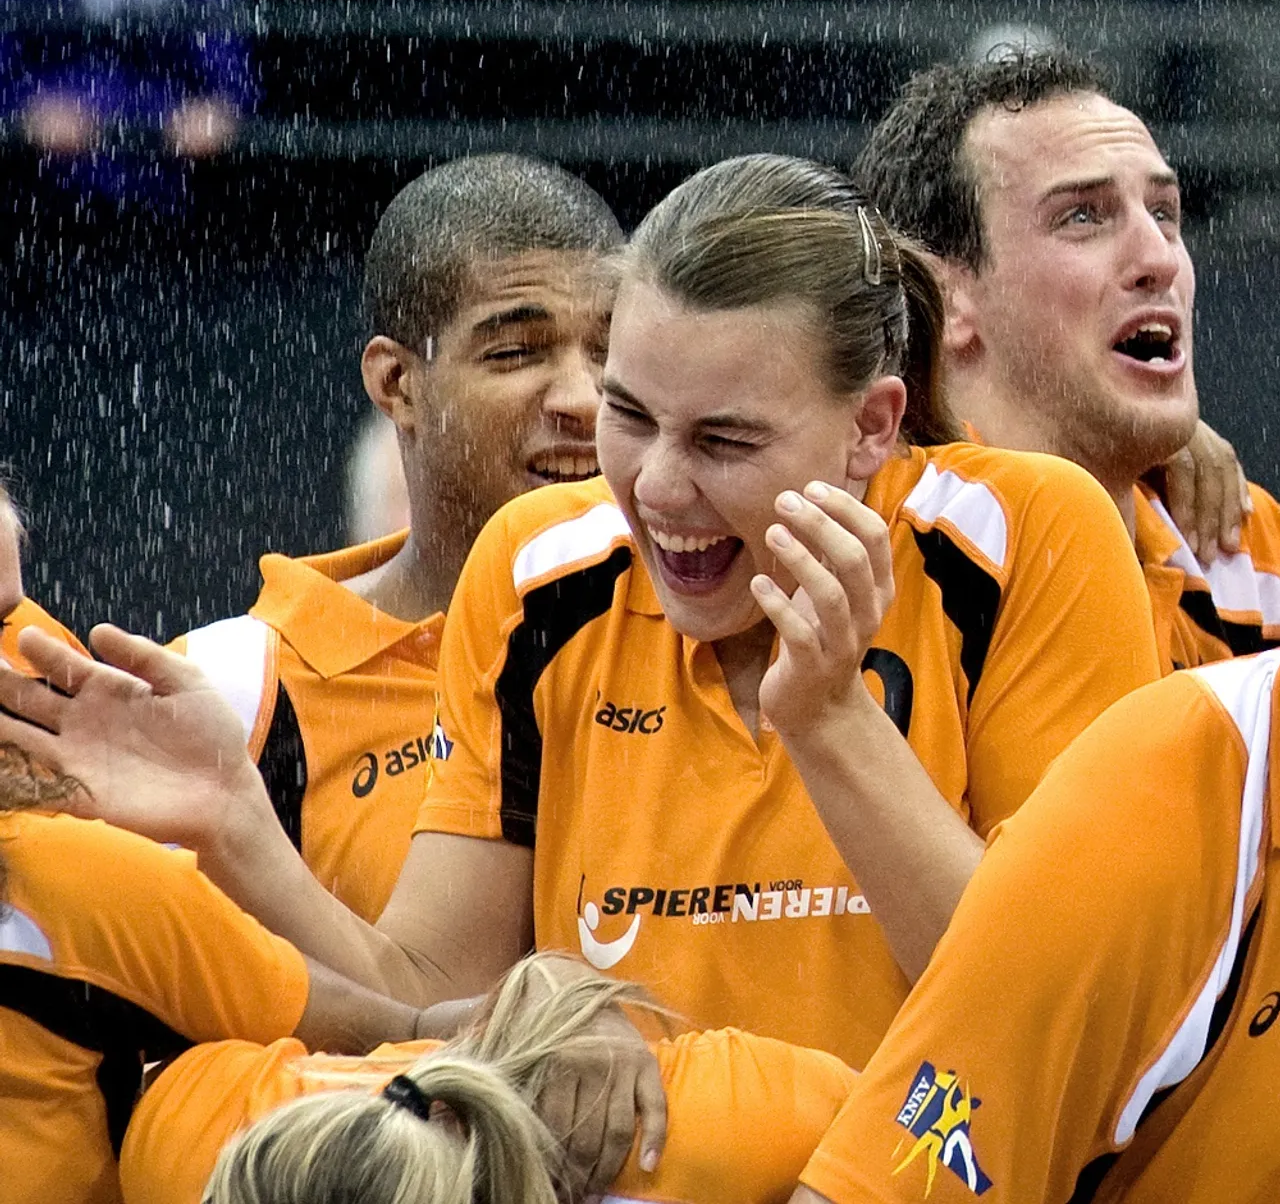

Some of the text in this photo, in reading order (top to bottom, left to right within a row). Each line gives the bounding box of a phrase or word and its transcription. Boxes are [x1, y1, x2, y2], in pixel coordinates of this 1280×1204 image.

[595, 701, 667, 734] asics
[602, 879, 803, 917] SPIEREN VOOR
[731, 886, 872, 924] PIEREN
[896, 1076, 931, 1126] KNKV
